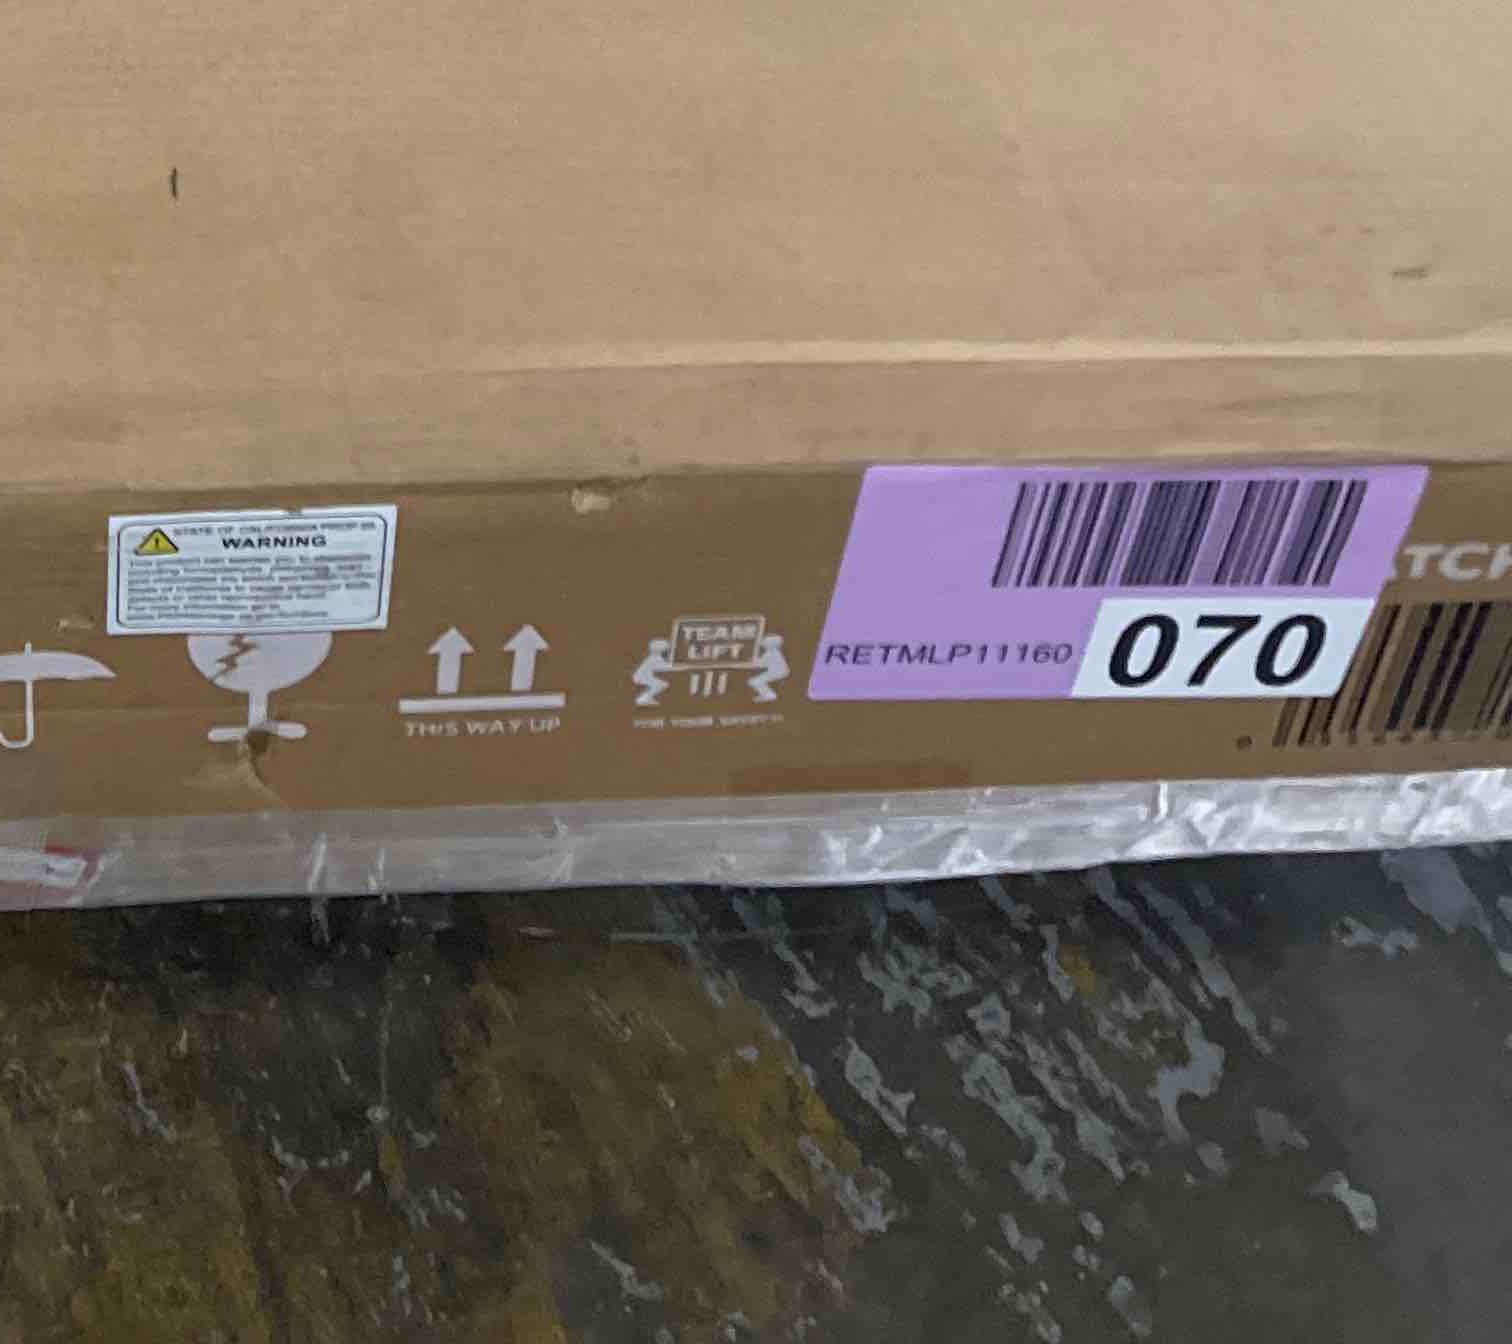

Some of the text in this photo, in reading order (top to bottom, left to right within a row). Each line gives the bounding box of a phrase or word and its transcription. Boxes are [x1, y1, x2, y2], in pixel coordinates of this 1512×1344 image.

[221, 534, 328, 551] WARNING
[682, 624, 758, 641] TEAM
[688, 642, 745, 660] LIFT
[824, 641, 1074, 667] RETMLP11160
[1106, 613, 1328, 690] 070
[404, 715, 561, 738] THIS WAY UP
